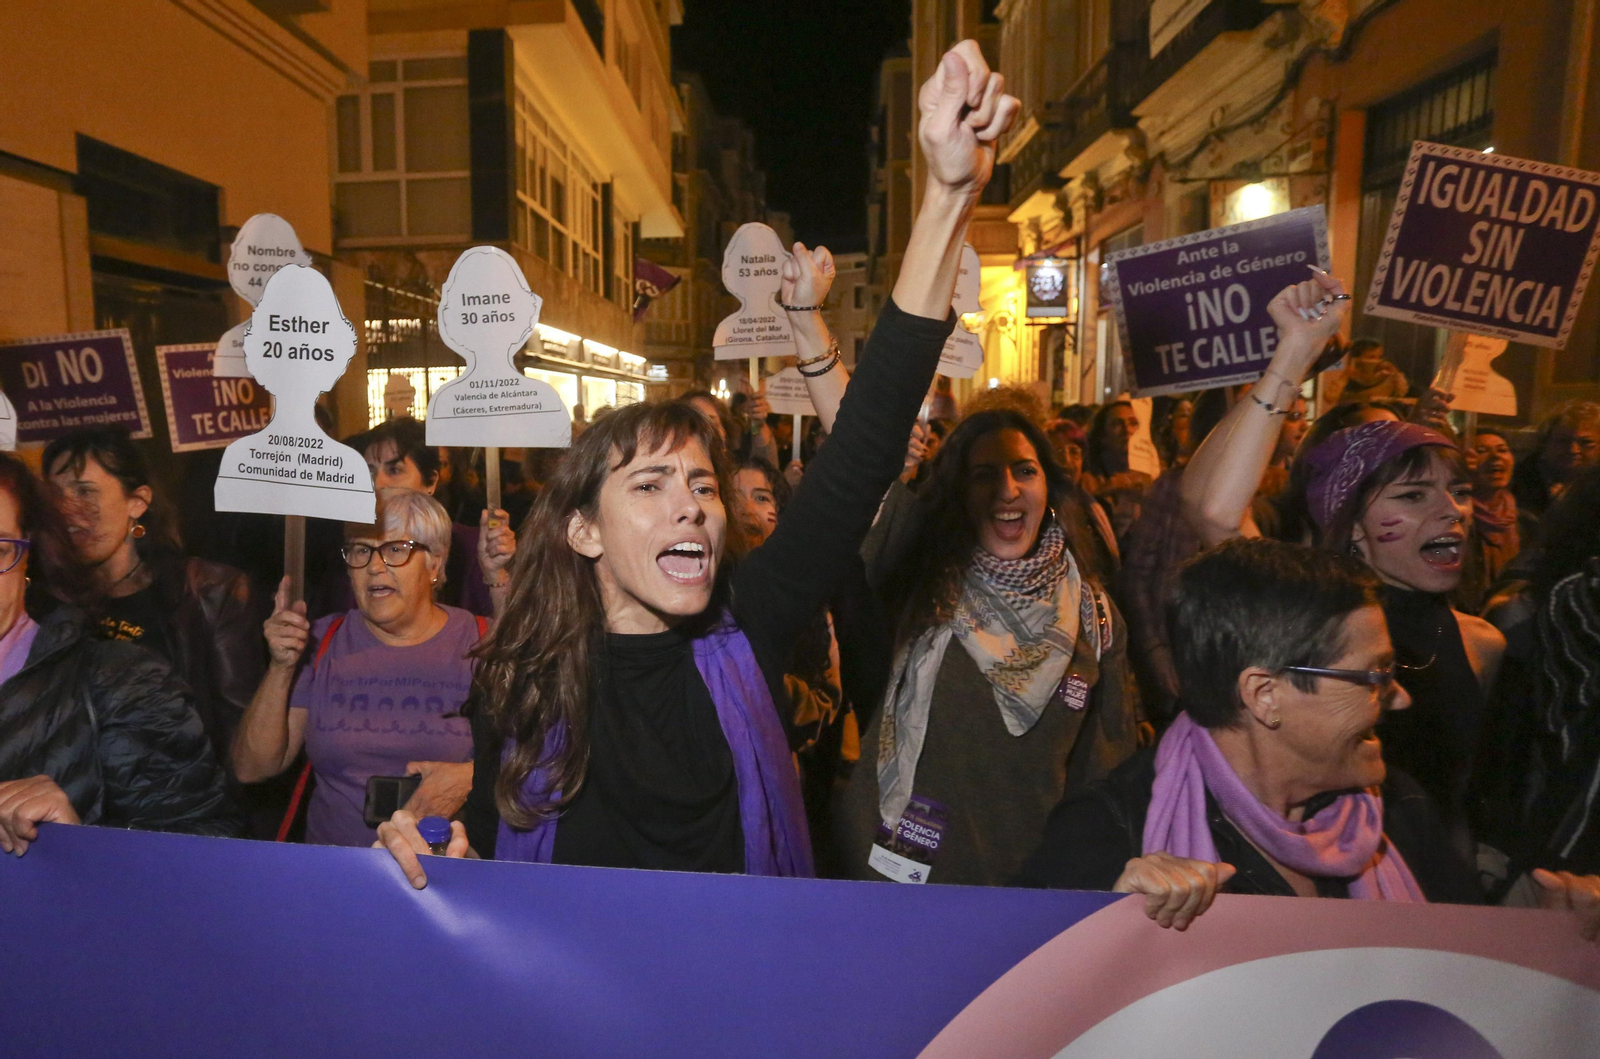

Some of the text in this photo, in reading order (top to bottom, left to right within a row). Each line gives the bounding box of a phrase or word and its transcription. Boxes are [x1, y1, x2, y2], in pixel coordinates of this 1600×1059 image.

[1417, 161, 1596, 233] IGUALDAD
[247, 245, 296, 258] Nombre
[1177, 240, 1240, 265] Ante la
[1461, 220, 1525, 271] SIN
[233, 263, 250, 271] no
[741, 254, 777, 264] Natalia
[248, 277, 262, 287] 44
[739, 267, 779, 277] 53 años
[1127, 250, 1307, 297] Violencia de Género
[462, 293, 511, 306] Imane
[1391, 257, 1561, 329] VIOLENCIA
[1185, 283, 1251, 330] ¡NO
[269, 314, 330, 334] Esther
[461, 309, 516, 325] 30 años
[263, 341, 283, 358] 20
[288, 343, 335, 361] años
[1154, 326, 1282, 375] TE CALLE
[22, 347, 103, 389] DI NO
[213, 378, 253, 407] ¡NO
[469, 378, 520, 389] 01/11/2022
[28, 401, 38, 412] A
[54, 394, 118, 410] Violencia
[454, 389, 538, 402] Valencia de Alcántara
[82, 410, 138, 425] mujeres
[452, 401, 542, 416] (Cáceres, Extremadura)
[191, 412, 215, 435] TE
[268, 434, 325, 449] 20/08/2022
[249, 448, 344, 470] Torrejón (Madrid)
[237, 462, 356, 486] Comunidad de Madrid
[903, 829, 938, 849] GÉNERO
